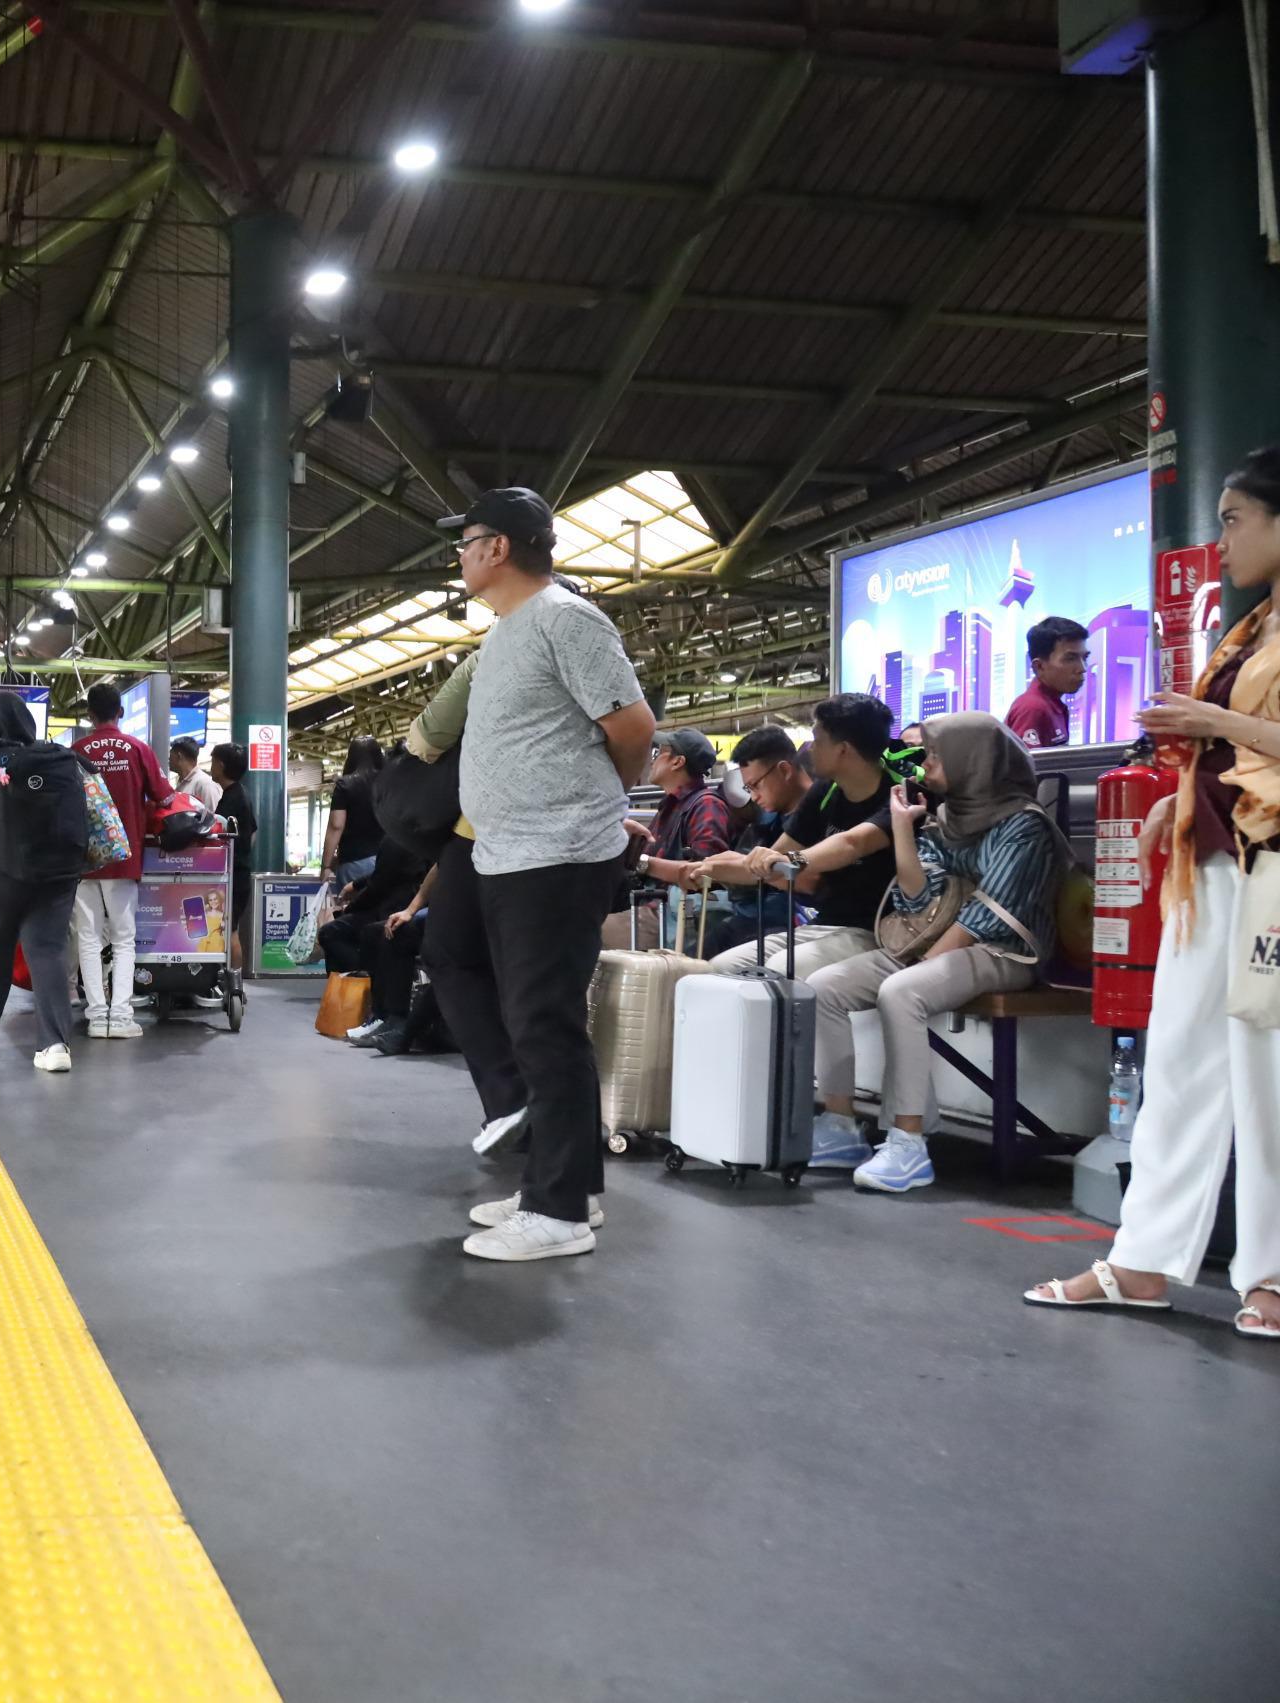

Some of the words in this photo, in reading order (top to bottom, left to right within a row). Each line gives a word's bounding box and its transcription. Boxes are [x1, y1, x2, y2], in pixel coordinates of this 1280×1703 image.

[83, 738, 132, 754] PORTER
[102, 750, 115, 760] 49
[265, 928, 289, 936] Organik
[170, 955, 182, 963] 48
